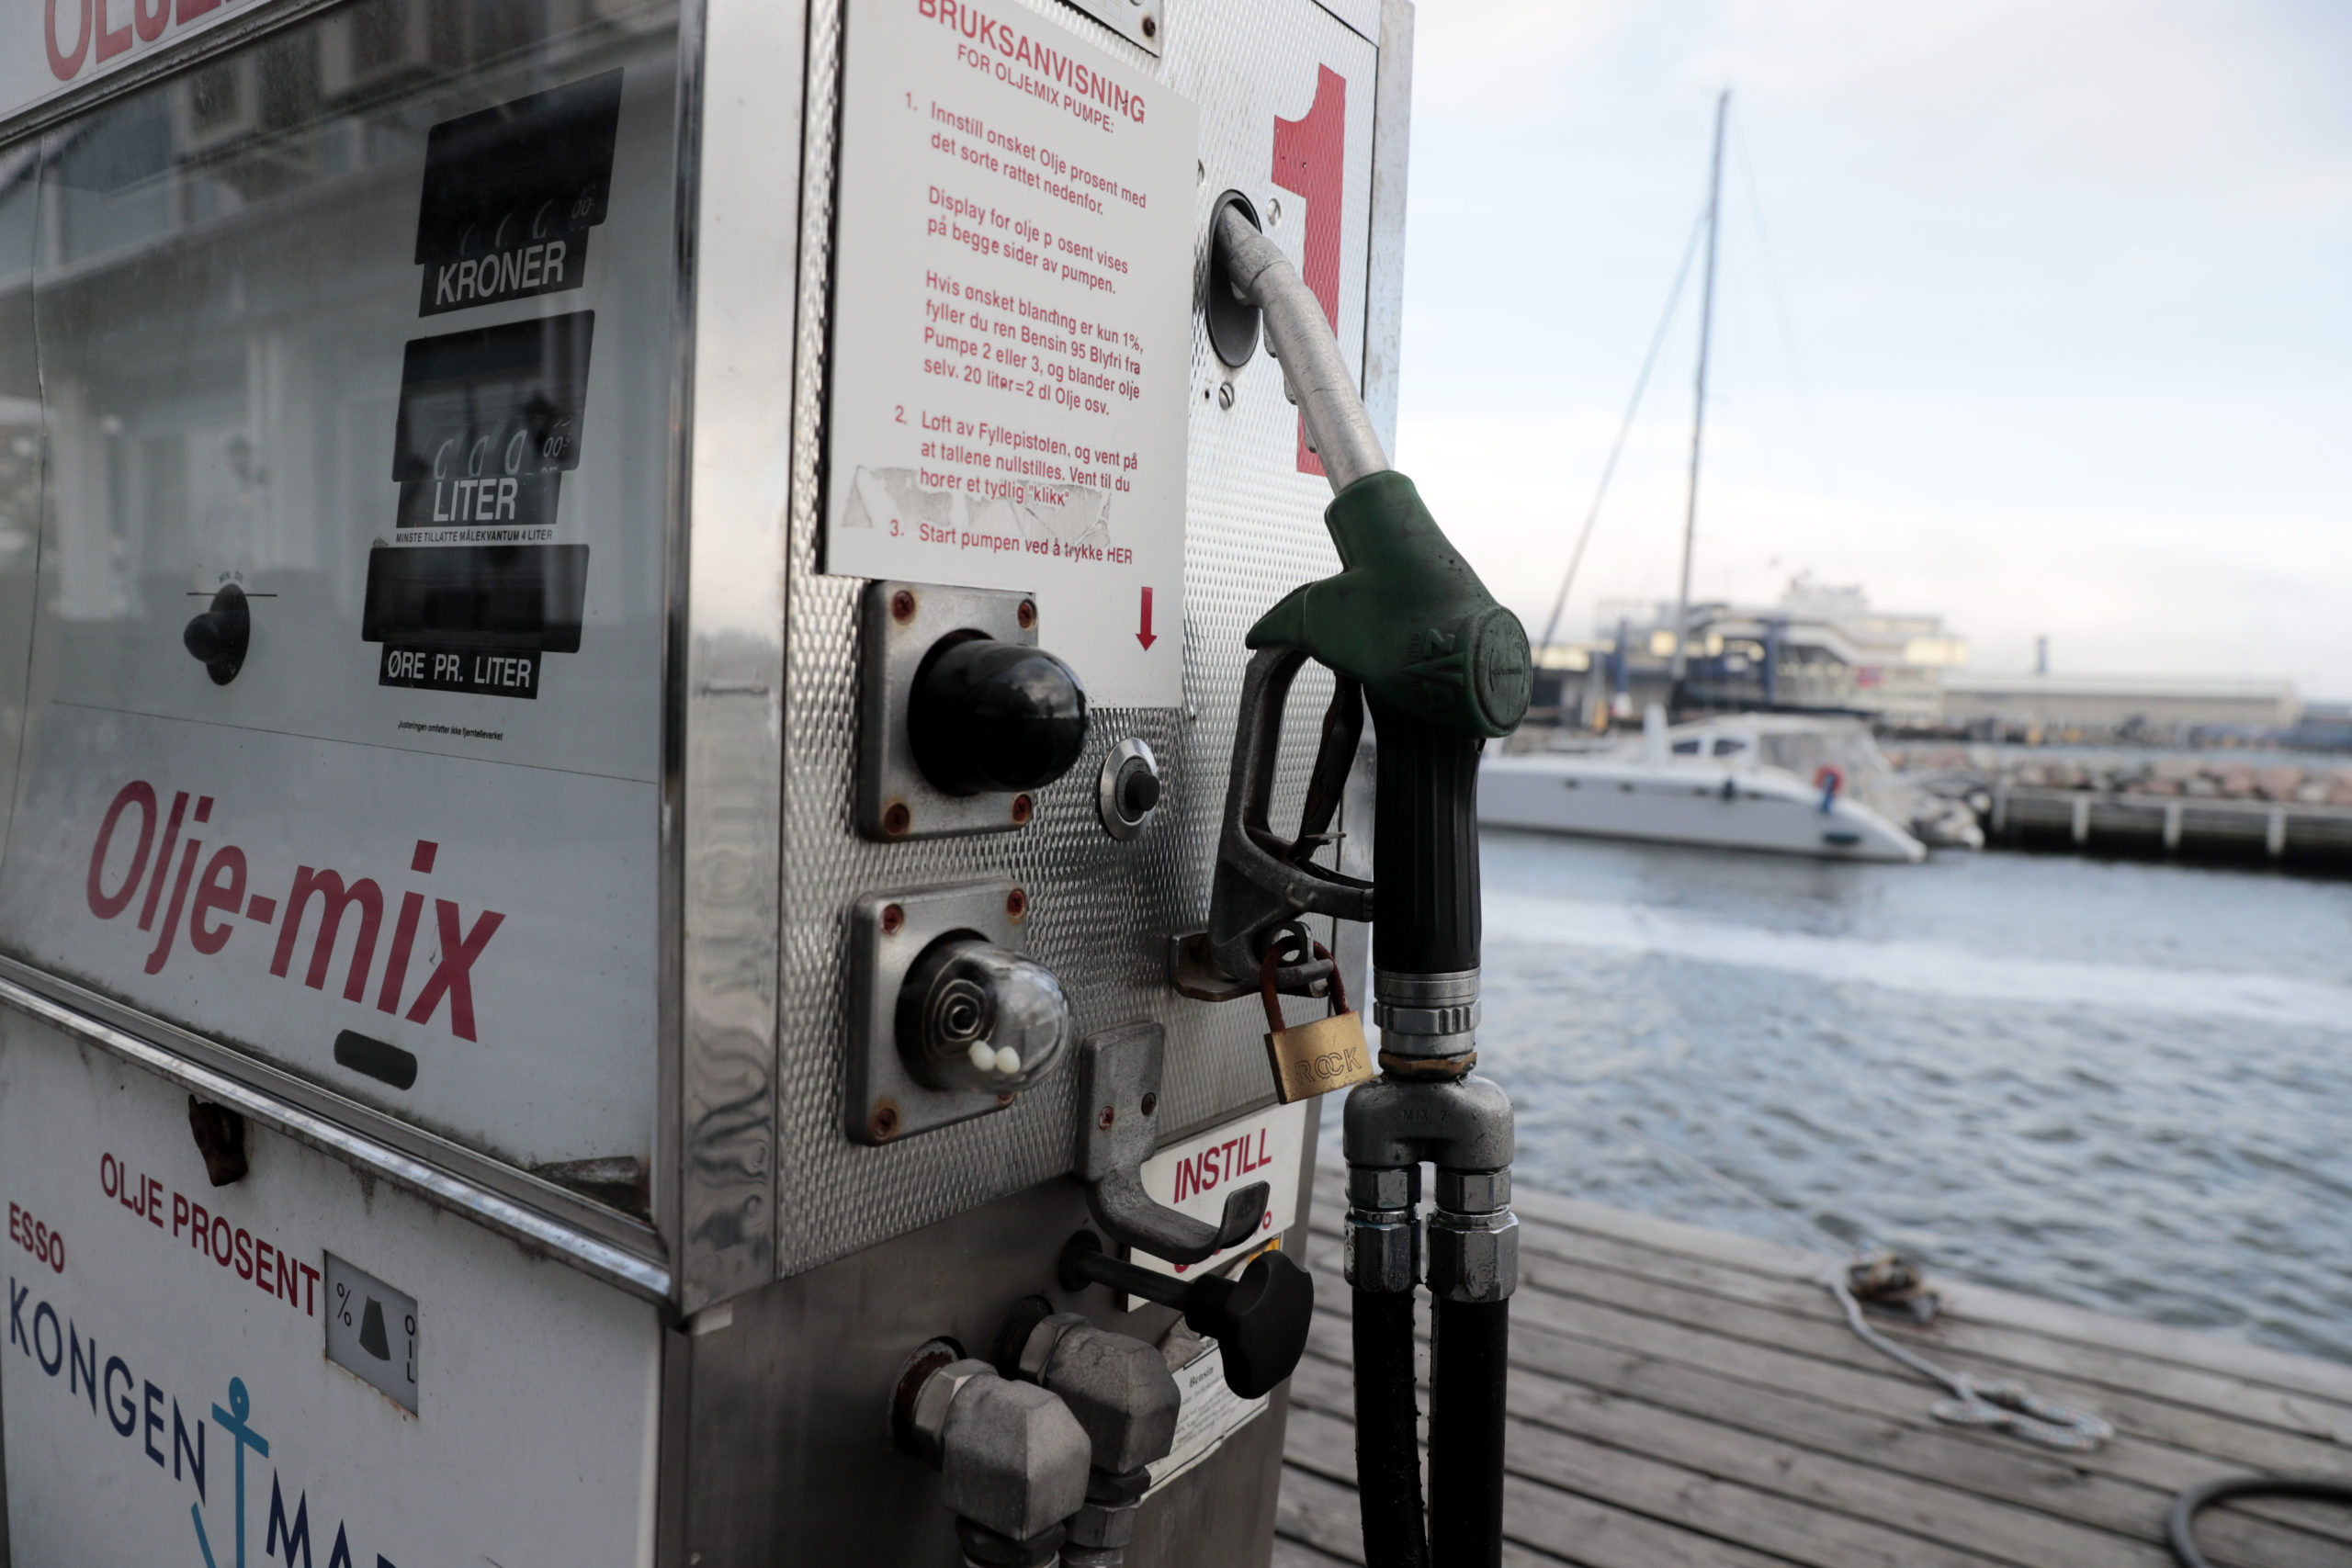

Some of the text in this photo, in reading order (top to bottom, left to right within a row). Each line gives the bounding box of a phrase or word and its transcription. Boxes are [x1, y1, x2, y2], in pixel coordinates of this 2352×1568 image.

[956, 42, 1114, 134] FOR OLJEMIX PUMPE:
[905, 91, 917, 111] 1.
[931, 100, 984, 138] Innstill
[1039, 147, 1067, 175] Olje
[1069, 164, 1118, 196] prosent
[1121, 186, 1147, 209] med
[930, 131, 1102, 214] det sorte rattet nedenfor.
[926, 213, 1115, 294] på begge sider av pumpen.
[928, 185, 986, 226] Display
[989, 208, 1011, 230] for
[1013, 220, 1041, 243] olje
[1097, 252, 1129, 275] vises
[435, 240, 567, 305] KRONER
[1272, 62, 1346, 477] 1
[925, 270, 1143, 355] Hvis ønsket blanding er kun 1%,
[925, 298, 1140, 375] fyller du ren Bensin 95 Blyfri fra
[923, 325, 978, 357] Pumpe
[981, 341, 992, 360] 2
[994, 348, 1027, 368] eller
[1046, 362, 1064, 383] og
[1068, 366, 1116, 391] blander
[1117, 381, 1140, 401] olje
[923, 357, 1109, 415] selv. 20 liter=2 dl Olje osv.
[894, 403, 908, 425] 2.
[955, 420, 975, 437] av
[1074, 445, 1091, 465] og
[1093, 450, 1120, 467] vent
[1123, 455, 1138, 470] på
[920, 441, 1131, 493] at tallene nullstilles. Vent til du
[433, 477, 518, 522] LITER
[966, 476, 981, 493] et
[984, 479, 1025, 505] tydlig
[396, 528, 553, 543] MINSTE TILLATTE MÅLEKVANTUM 4 LITER
[888, 517, 1133, 564] 3. Start pumpen ved å trykke HER
[388, 649, 532, 688] ØRE PR. LITER
[450, 725, 462, 737] ikke
[86, 780, 506, 1043] Olje-mix
[1294, 1046, 1362, 1085] ROCK
[1173, 1127, 1272, 1204] INSTILL
[8, 1201, 65, 1274] ESSO
[100, 1152, 320, 1317] OLJE PROSENT
[336, 1282, 352, 1327] %
[404, 1314, 416, 1384] OIL
[10, 1276, 206, 1508] KONGEN
